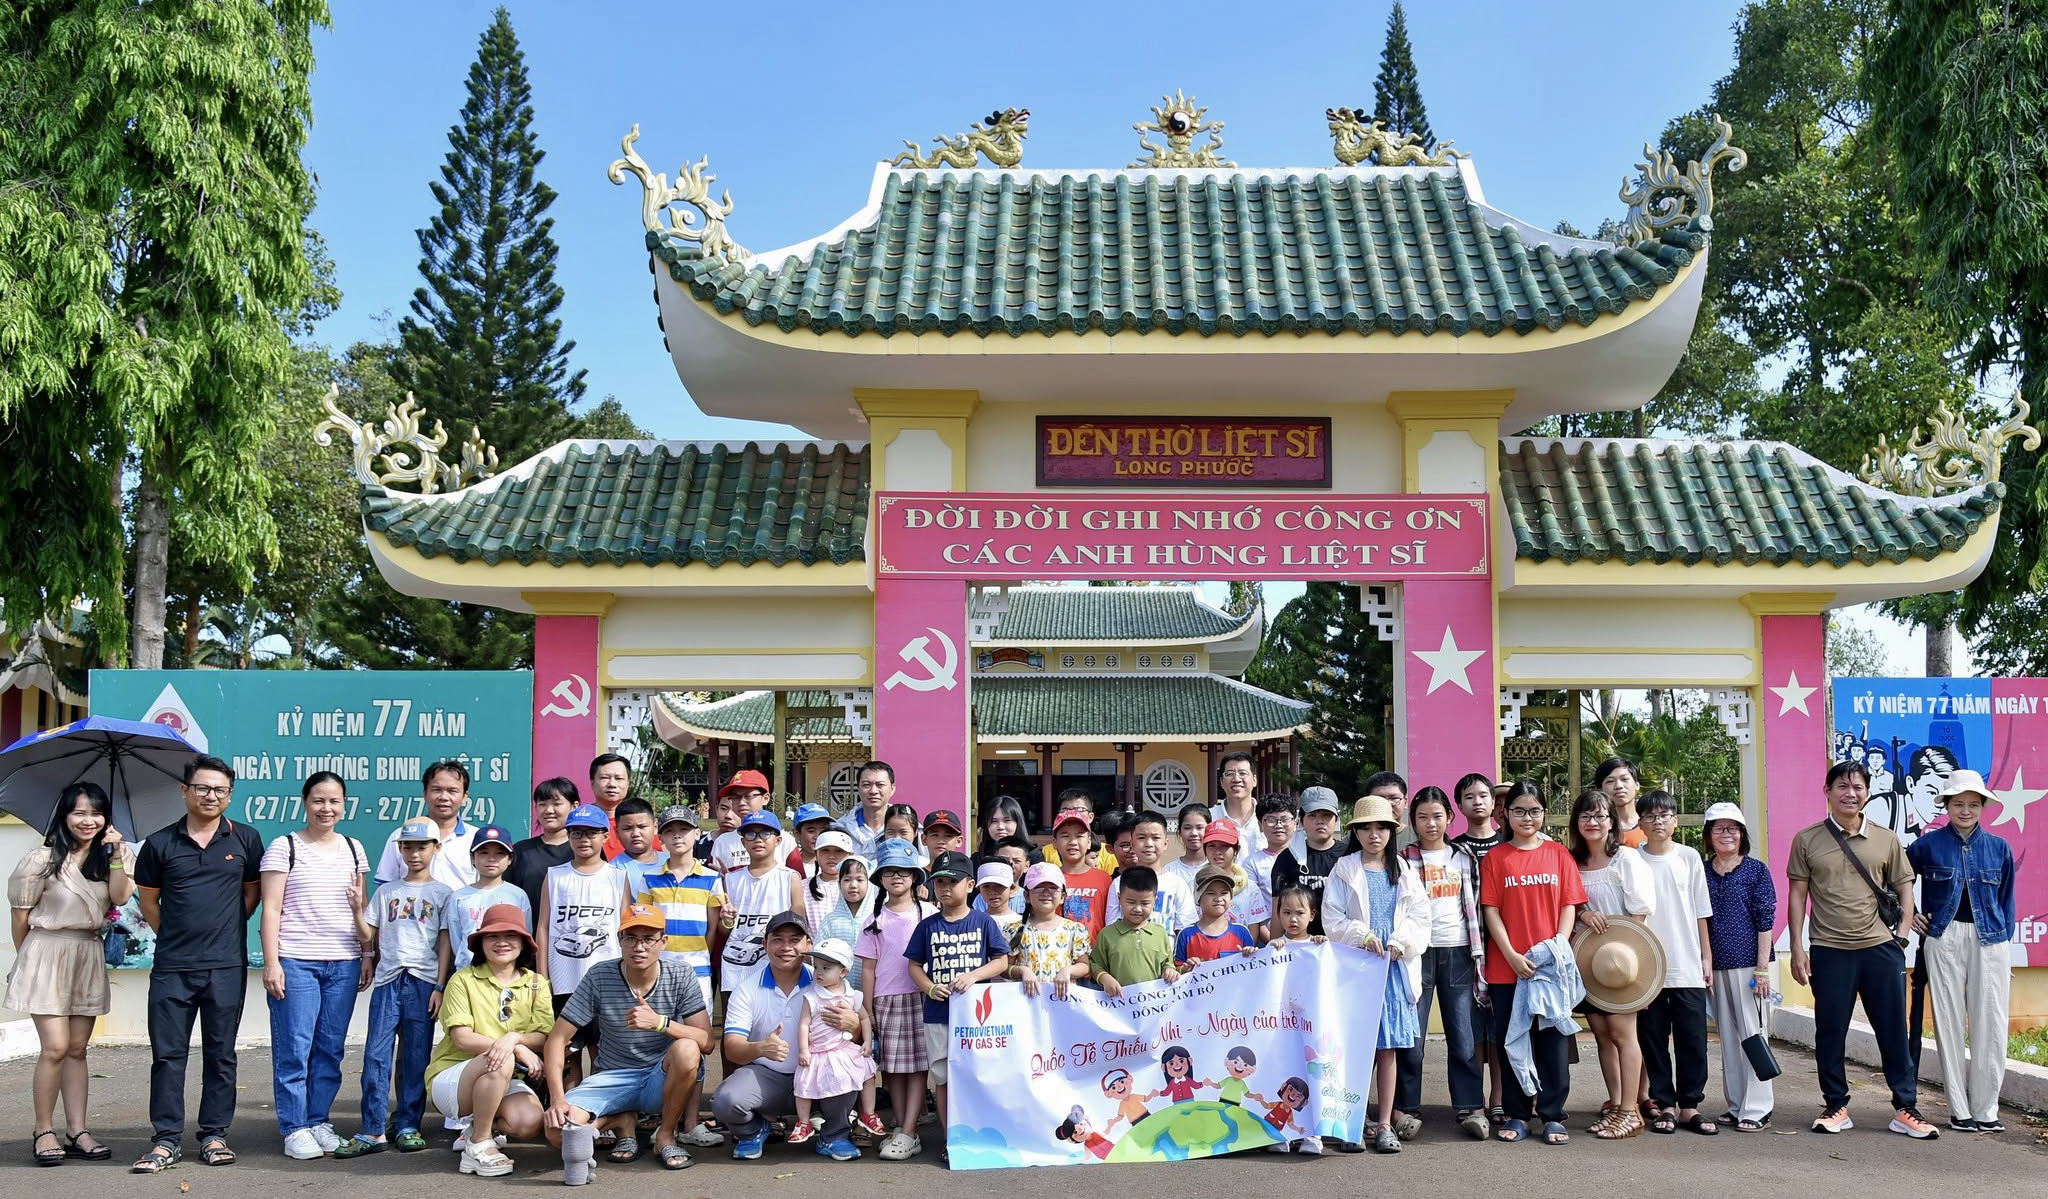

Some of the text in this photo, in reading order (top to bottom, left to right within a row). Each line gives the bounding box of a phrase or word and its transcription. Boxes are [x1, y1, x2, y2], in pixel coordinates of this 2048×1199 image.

[1125, 424, 1194, 456] THỜ
[1198, 425, 1280, 460] LIỆT
[1286, 425, 1324, 458] SĨ
[1113, 456, 1254, 475] LONG PHƯỚC
[904, 503, 1462, 531] ĐỜI ĐỜI GHI NHỚ CÔNG ƠN
[942, 538, 1428, 568] CÁC ANH HÙNG LIỆT SĨ
[1854, 691, 1874, 713] KỶ
[1880, 693, 1922, 717] NIỆM
[1926, 697, 1948, 714] 77
[1952, 694, 1990, 714] NĂM
[1995, 694, 2038, 714] NGÀY
[277, 699, 466, 741] KỶ NIỆM 77 NĂM
[232, 752, 286, 780] NGÀY
[376, 756, 420, 780] BINH
[490, 753, 511, 782] SĨ
[1425, 868, 1444, 881] IET
[1504, 875, 1518, 888] JIL
[1066, 888, 1098, 897] EART
[557, 905, 615, 923] SPEED
[736, 914, 772, 929] PEE
[930, 928, 982, 945] Ahonui
[2013, 915, 2048, 943] IẾP
[932, 954, 982, 970] Akaihu
[1129, 990, 1166, 1005] CÔNG
[1185, 972, 1208, 984] ẬN
[1212, 957, 1267, 978] CHUYỂN
[1270, 951, 1292, 965] KHÍ
[1132, 1004, 1168, 1019] ĐÔNG
[1197, 983, 1215, 995] BỘ
[954, 1024, 1013, 1038] PETROVIETNAM
[961, 1036, 1007, 1050] PV GAS SE
[1031, 1047, 1065, 1080] Quốc
[1101, 1036, 1147, 1061] Thiếu
[1151, 1021, 1183, 1049] Nhi
[1198, 1011, 1248, 1038] Ngày
[1253, 1010, 1277, 1030] của
[1281, 1010, 1299, 1030] trẻ
[1301, 1016, 1313, 1033] m
